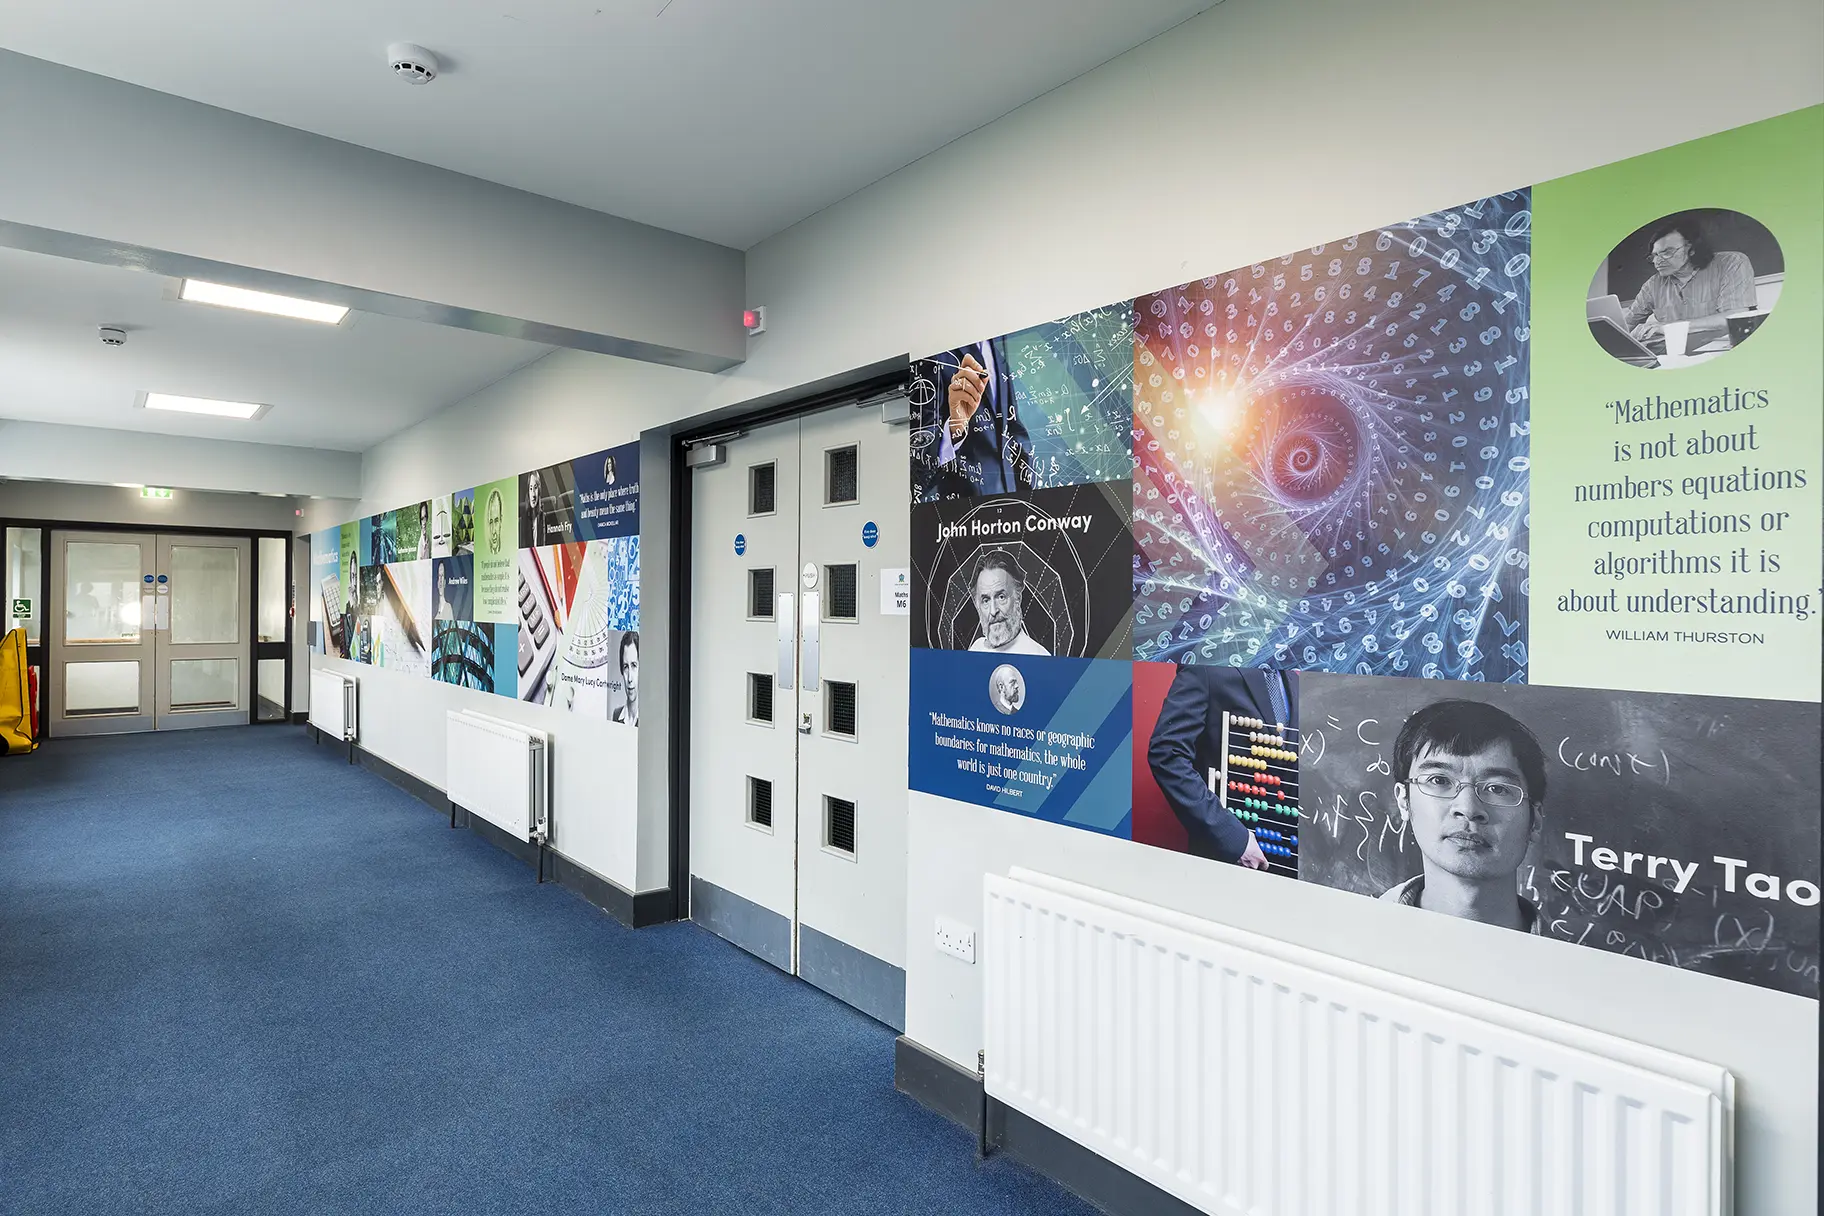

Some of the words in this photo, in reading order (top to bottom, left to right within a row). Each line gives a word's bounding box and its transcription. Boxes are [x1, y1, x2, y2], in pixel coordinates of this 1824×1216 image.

[1605, 387, 1769, 424] “Mathematics
[1614, 441, 1632, 462] is
[1640, 433, 1679, 460] not
[1686, 425, 1760, 456] about
[608, 488, 617, 500] place
[618, 486, 628, 497] where
[629, 482, 639, 494] truth
[1575, 475, 1674, 502] numbers
[1682, 466, 1807, 500] equations
[615, 504, 625, 513] same
[547, 523, 564, 533] Hannah
[564, 521, 573, 533] Fry
[936, 523, 967, 543] John
[972, 519, 1021, 536] Horton
[1025, 514, 1093, 533] Conway
[1588, 510, 1751, 542] computations
[1761, 511, 1790, 532] or
[1594, 550, 1722, 581] algorithms
[1731, 548, 1751, 573] it
[1760, 550, 1781, 573] is
[897, 600, 907, 608] M6
[1557, 589, 1620, 613] about
[1606, 630, 1669, 641] WILLIAM
[1674, 631, 1764, 644] THURSTON
[561, 673, 573, 682] Dame
[574, 675, 585, 687] Mary
[585, 677, 596, 689] Lucy
[596, 678, 622, 692] Cartwright
[977, 718, 1000, 735] knows
[1001, 724, 1011, 736] no
[1013, 726, 1035, 740] races
[1036, 730, 1046, 741] or
[1047, 731, 1096, 750] geographic
[976, 738, 988, 754] for
[989, 743, 1042, 765] mathematics,
[1044, 750, 1059, 766] the
[1060, 753, 1086, 771] whole
[957, 758, 978, 773] world
[979, 762, 985, 774] is
[986, 762, 1002, 778] just
[1003, 768, 1018, 780] one
[986, 783, 1001, 793] DAVID
[1001, 787, 1023, 798] HILBERT
[1565, 832, 1699, 893] Terry
[1714, 856, 1821, 906] Tao
